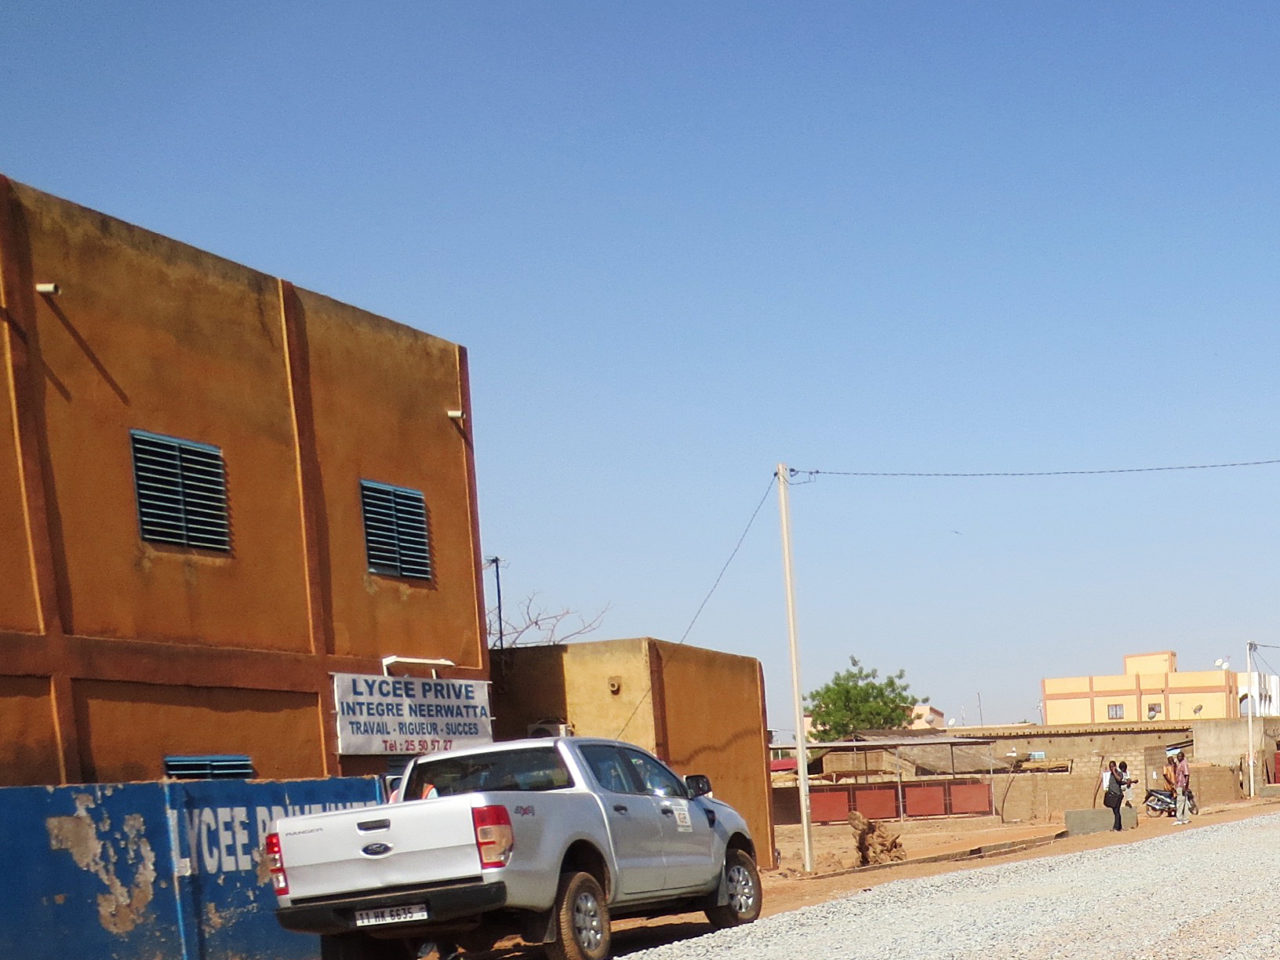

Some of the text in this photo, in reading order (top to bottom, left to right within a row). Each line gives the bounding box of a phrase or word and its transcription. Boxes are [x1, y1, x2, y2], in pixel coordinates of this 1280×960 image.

[352, 679, 475, 700] LYCEE PRIVE
[341, 702, 488, 719] INTEGRE NEERWATTA
[349, 721, 390, 735] TRAVAIL
[398, 723, 438, 736] RIGUEUR
[445, 723, 479, 736] SUCCES
[405, 740, 416, 751] 25
[419, 740, 428, 751] 50
[431, 740, 440, 751] 57
[443, 740, 453, 751] 27
[171, 807, 252, 876] LYCEE
